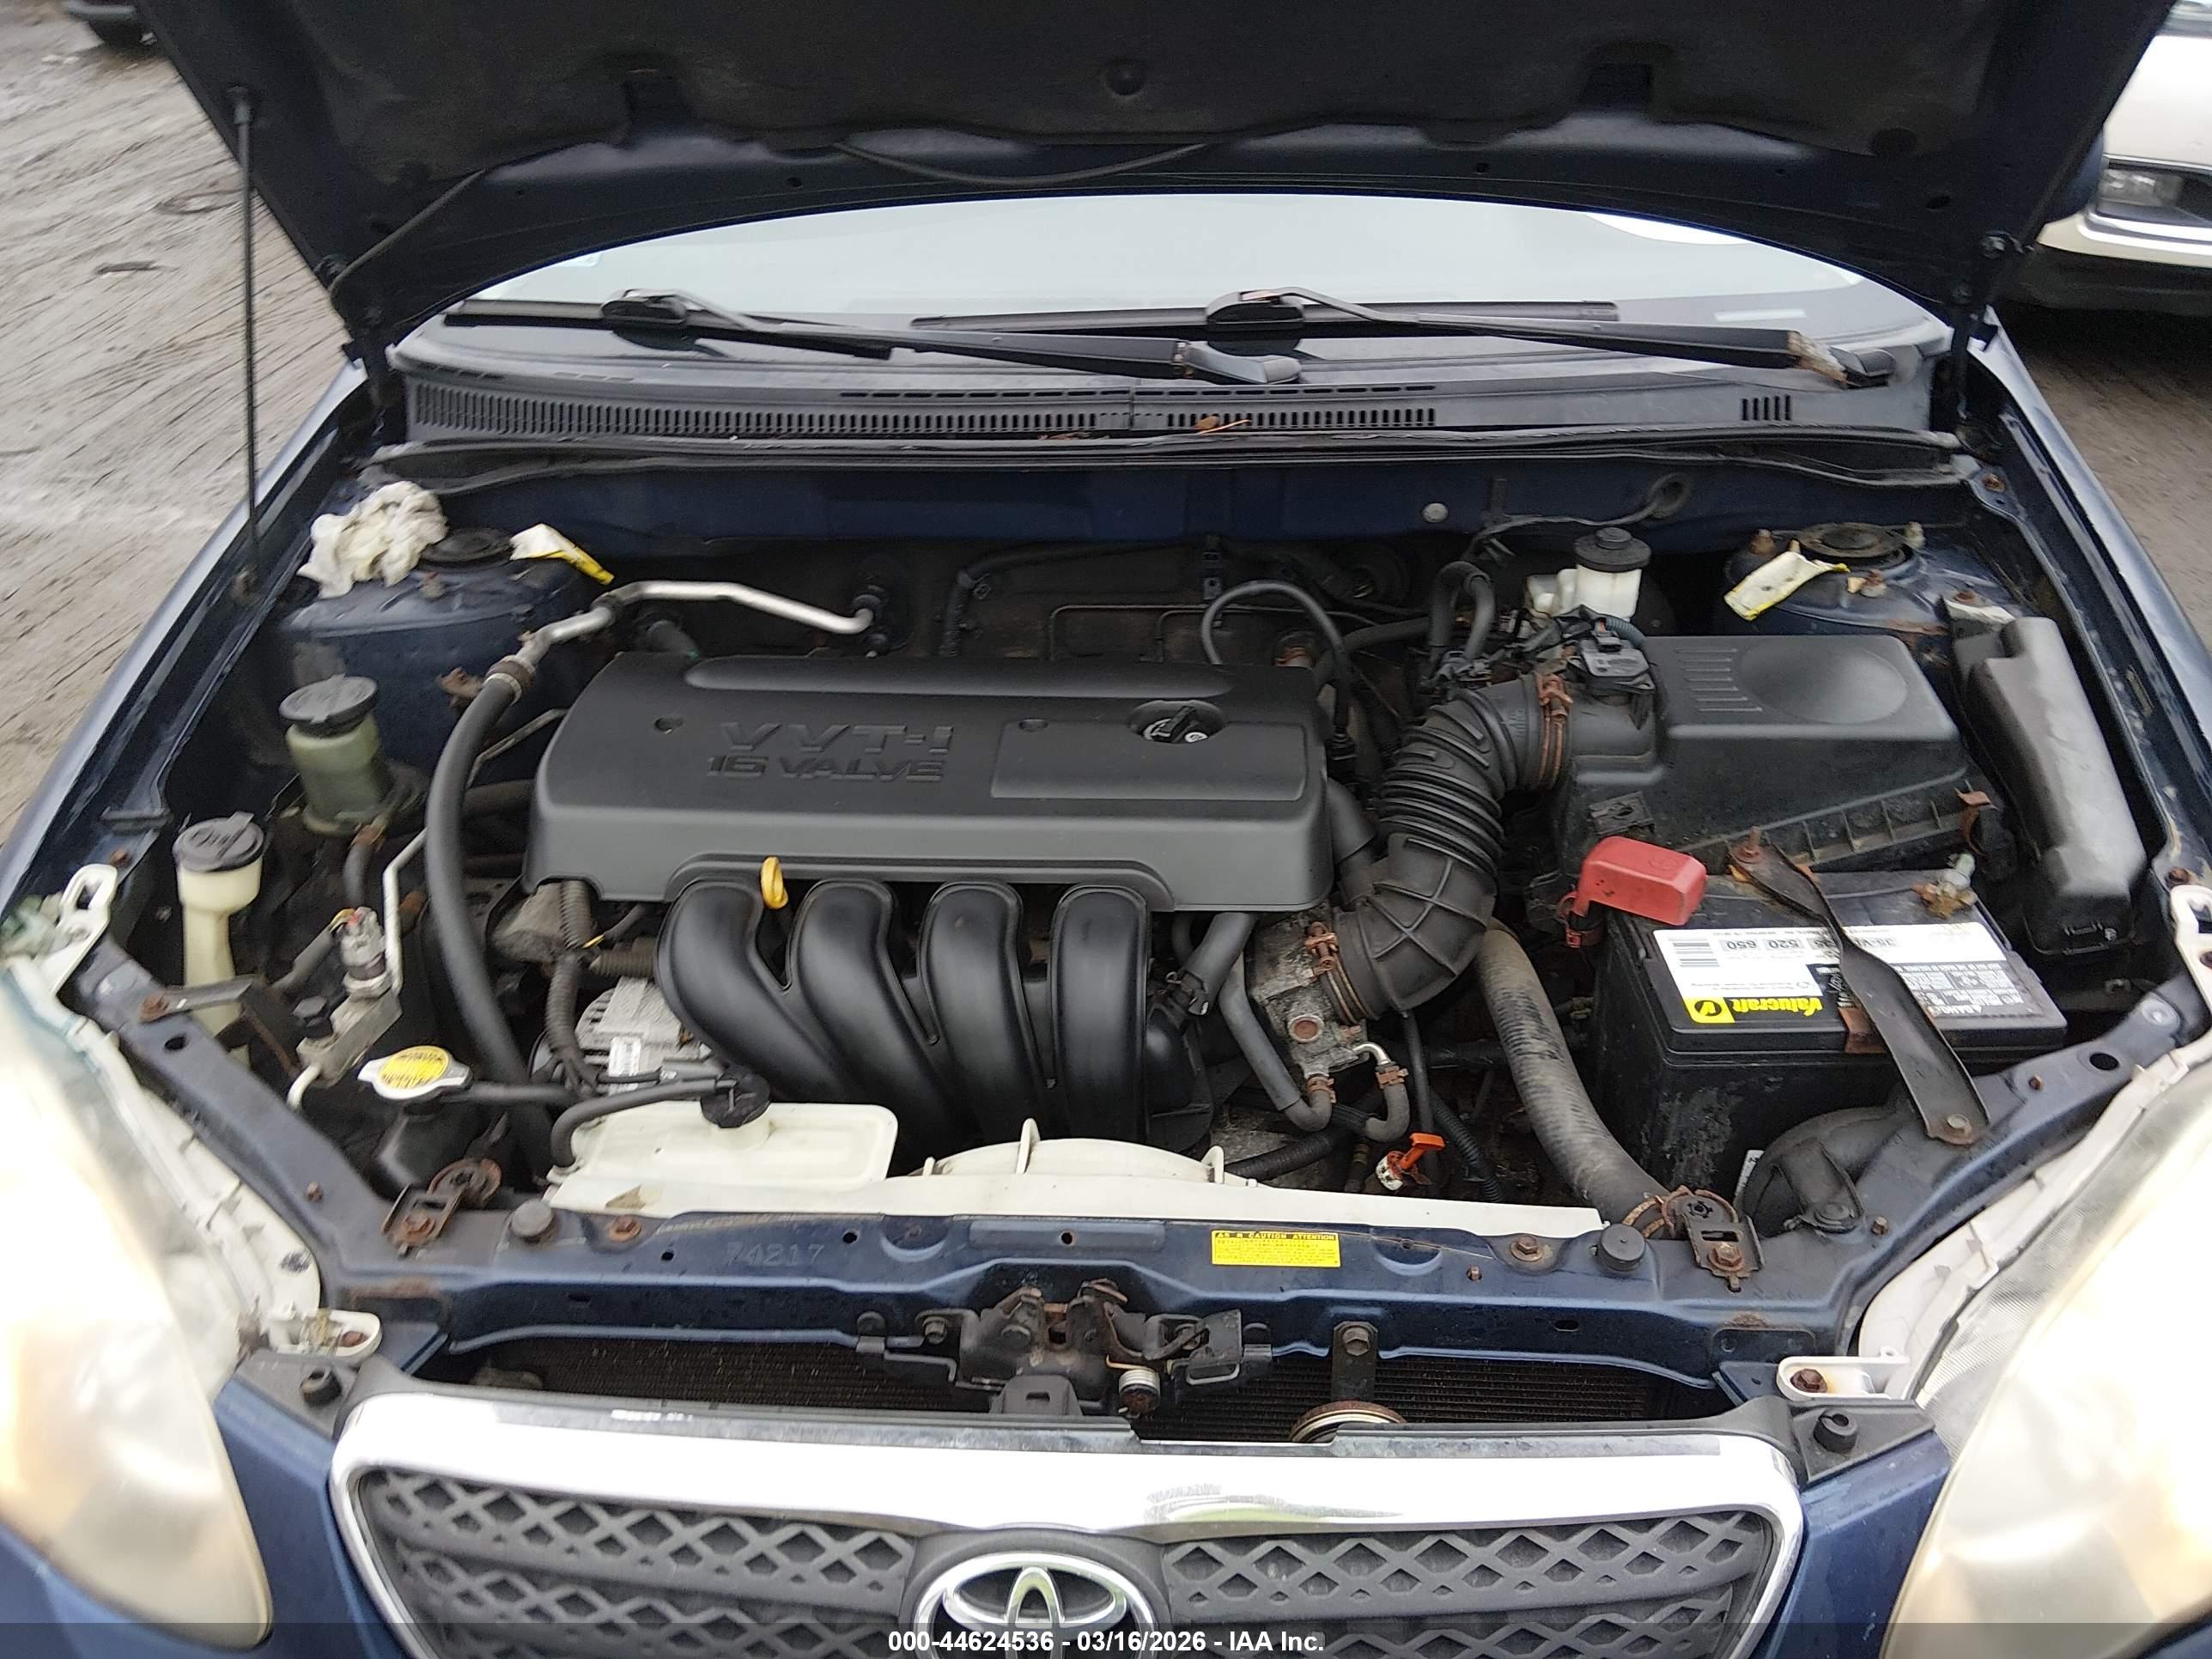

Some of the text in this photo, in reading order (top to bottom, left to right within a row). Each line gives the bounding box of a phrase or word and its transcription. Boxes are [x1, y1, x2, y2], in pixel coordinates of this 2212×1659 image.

[706, 755, 946, 782] 16 VALVE
[1726, 940, 1758, 951] 650
[1768, 939, 1800, 950] 520
[1730, 997, 1823, 1017] Valucraft
